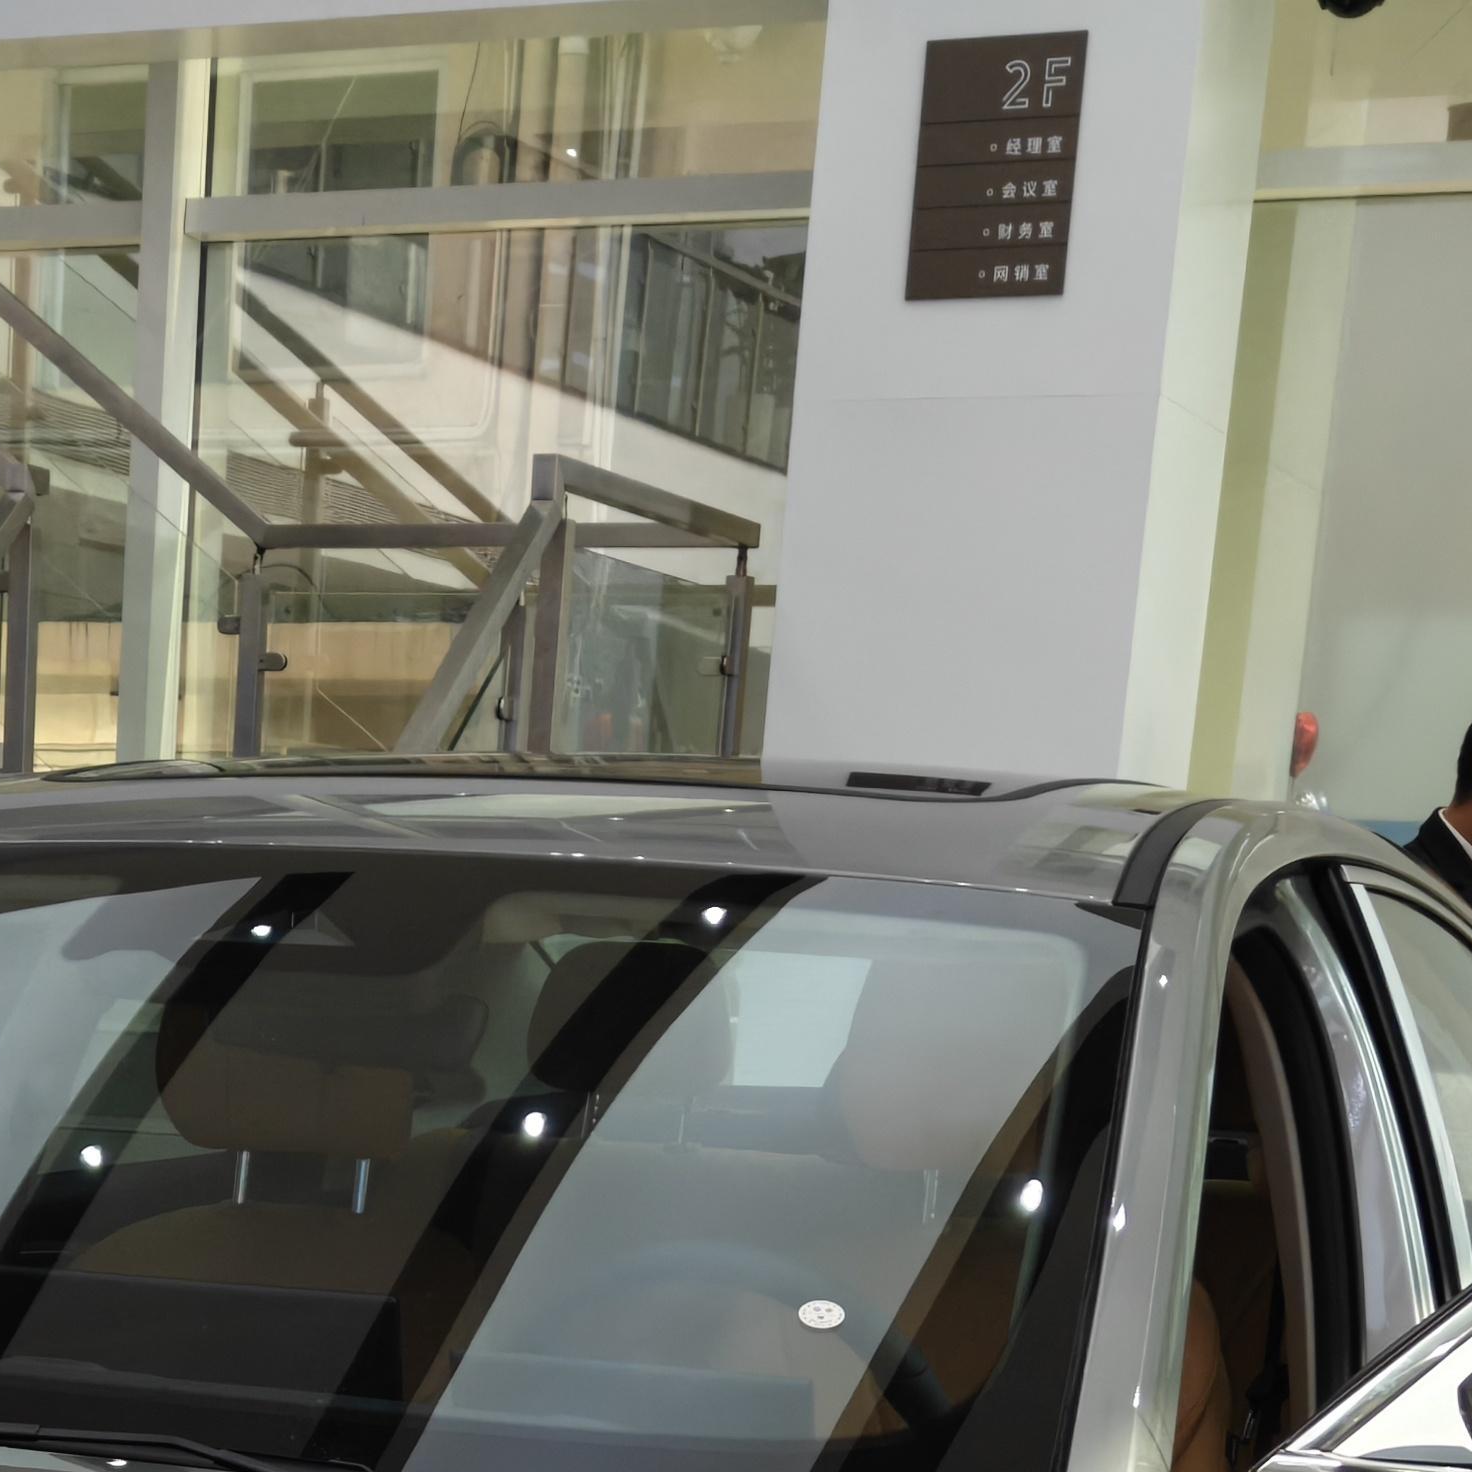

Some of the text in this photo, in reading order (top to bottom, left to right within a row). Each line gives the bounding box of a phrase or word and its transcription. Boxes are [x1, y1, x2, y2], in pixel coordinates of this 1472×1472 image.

[1002, 57, 1071, 110] 2F
[1005, 136, 1062, 155] 经理室
[1001, 179, 1058, 198] 会议室
[998, 221, 1054, 240] 财务室
[993, 264, 1049, 282] 网销室
